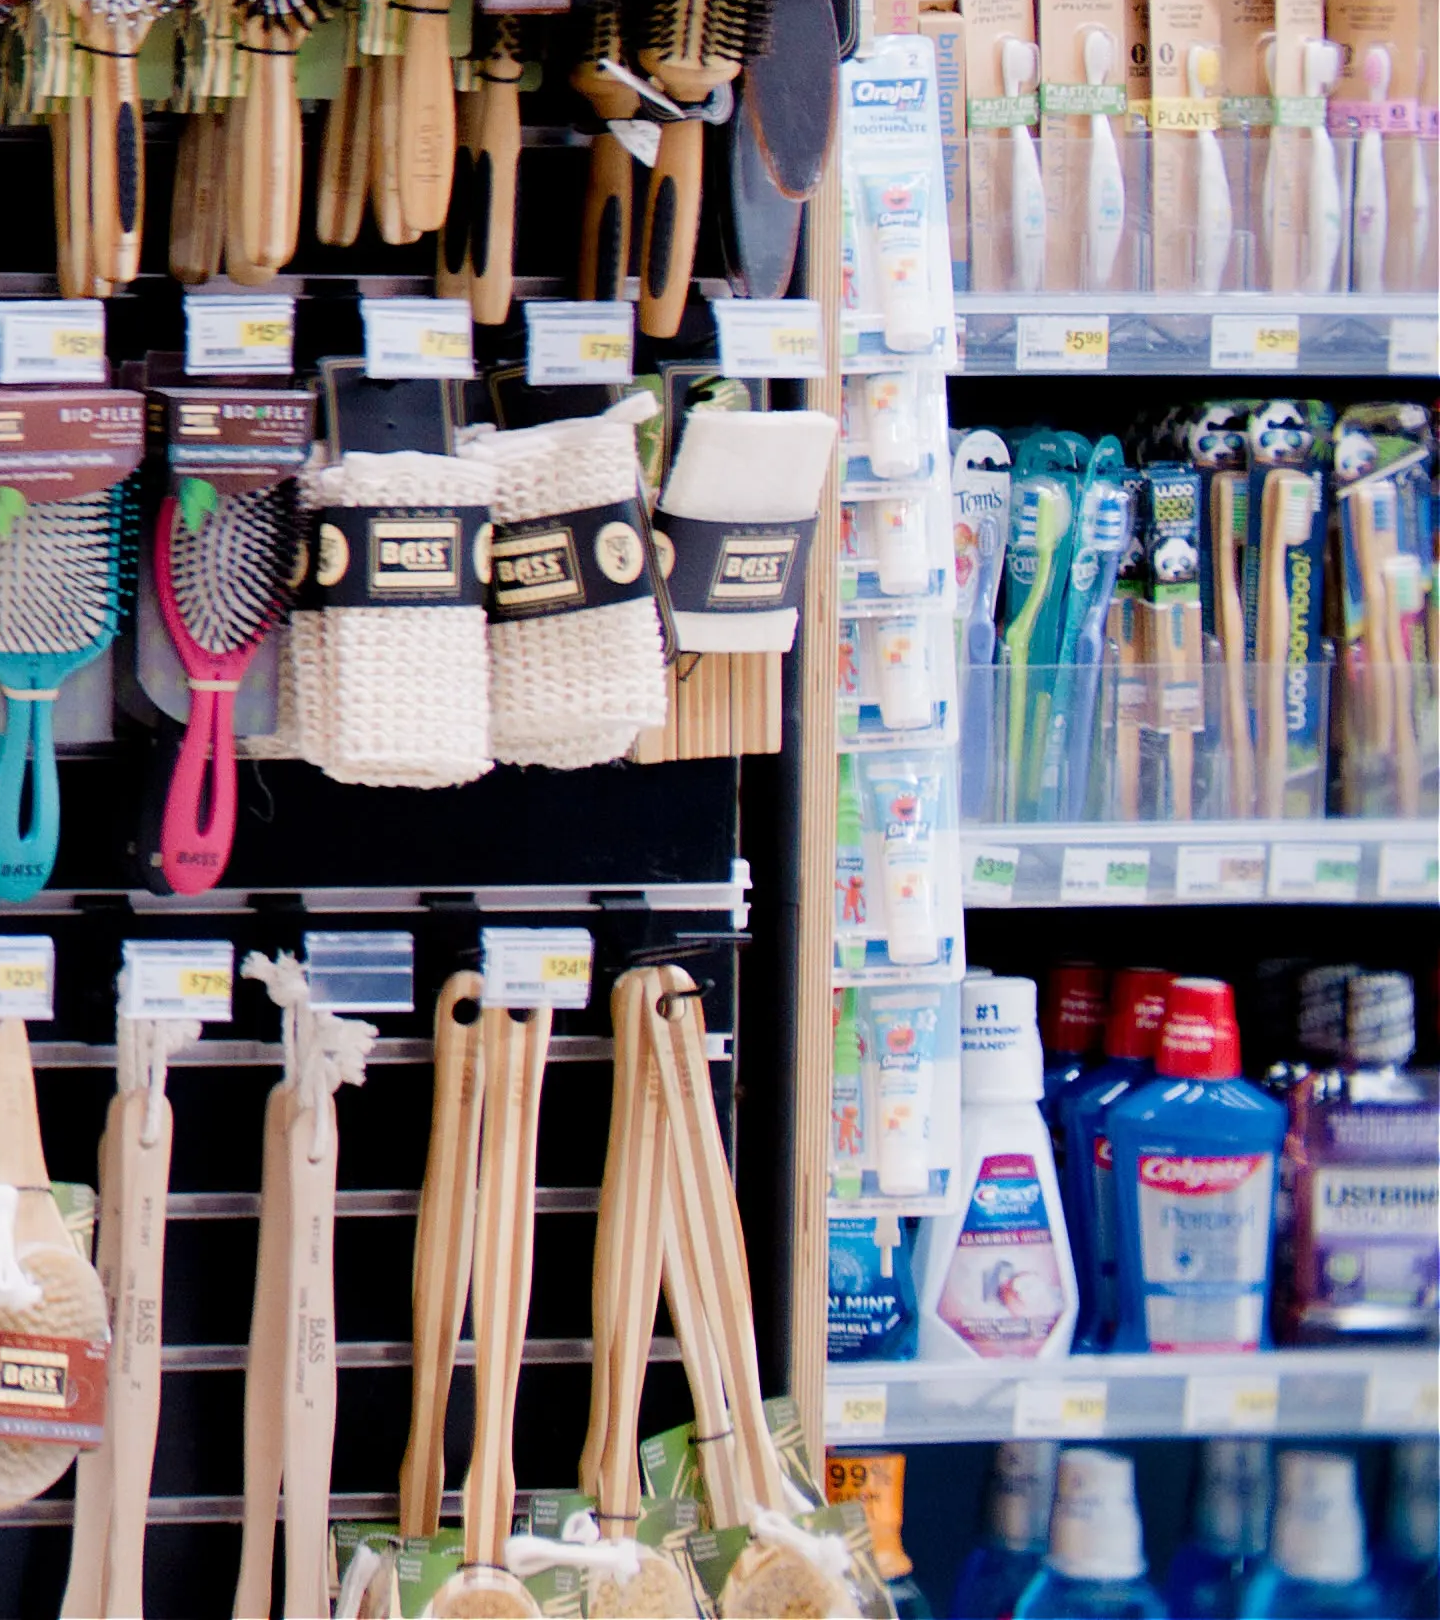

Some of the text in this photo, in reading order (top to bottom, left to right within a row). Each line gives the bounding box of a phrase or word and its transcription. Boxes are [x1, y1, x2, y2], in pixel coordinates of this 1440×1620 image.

[855, 79, 923, 104] Orajel
[938, 33, 960, 137] brilliant
[1046, 84, 1093, 99] PLASTIC
[853, 123, 928, 135] TOOTHPASTE
[1157, 110, 1219, 128] PLANTS
[954, 487, 1003, 516] Tom's
[381, 540, 447, 570] BASS
[725, 554, 782, 581] BASS
[496, 554, 562, 584] BASS
[976, 1003, 1000, 1021] #1
[1142, 1158, 1249, 1187] Colgate
[846, 1294, 897, 1313] MINT
[136, 1299, 157, 1345] BASS
[309, 1317, 327, 1364] BASS
[3, 1366, 62, 1390] BASS
